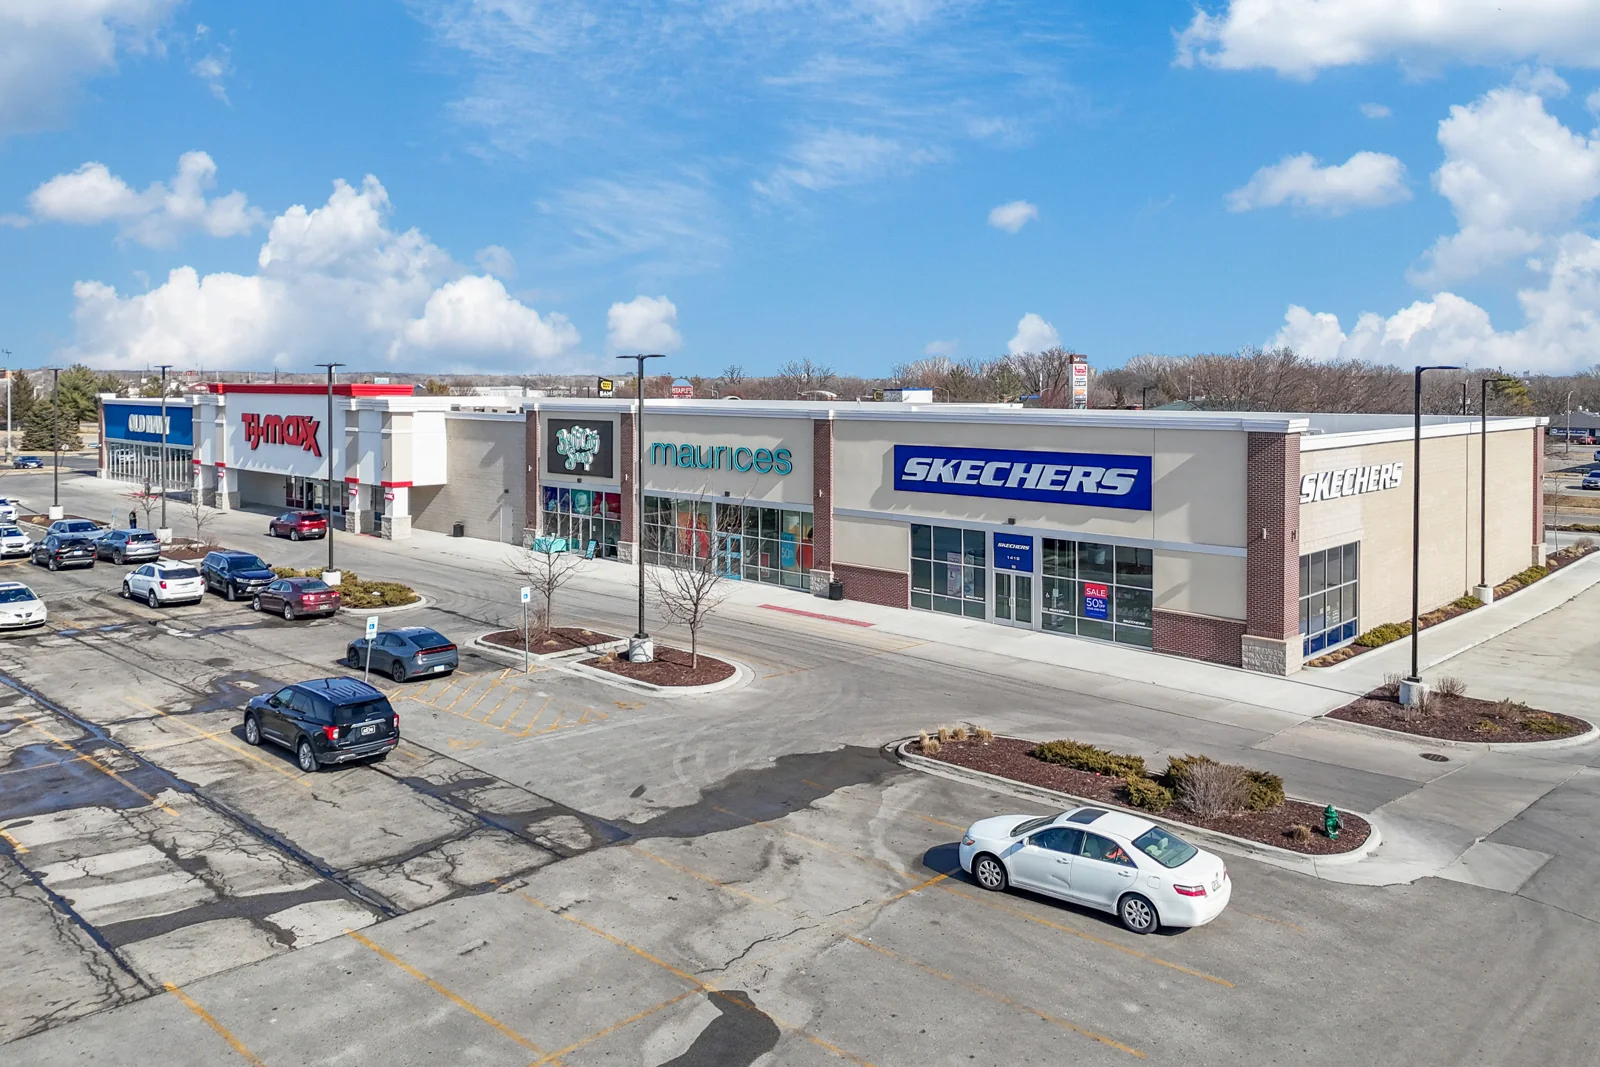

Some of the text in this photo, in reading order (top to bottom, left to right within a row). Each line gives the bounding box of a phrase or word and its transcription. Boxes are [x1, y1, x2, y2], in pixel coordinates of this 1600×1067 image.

[128, 413, 146, 433] OLD
[581, 428, 600, 454] City
[565, 447, 593, 471] Soap
[650, 441, 792, 476] maurices
[901, 456, 1139, 496] SKECHERS
[1299, 462, 1404, 504] SKECHERS
[997, 542, 1031, 551] SKECHERS
[1086, 587, 1105, 597] SALE
[1086, 597, 1103, 608] 50%
